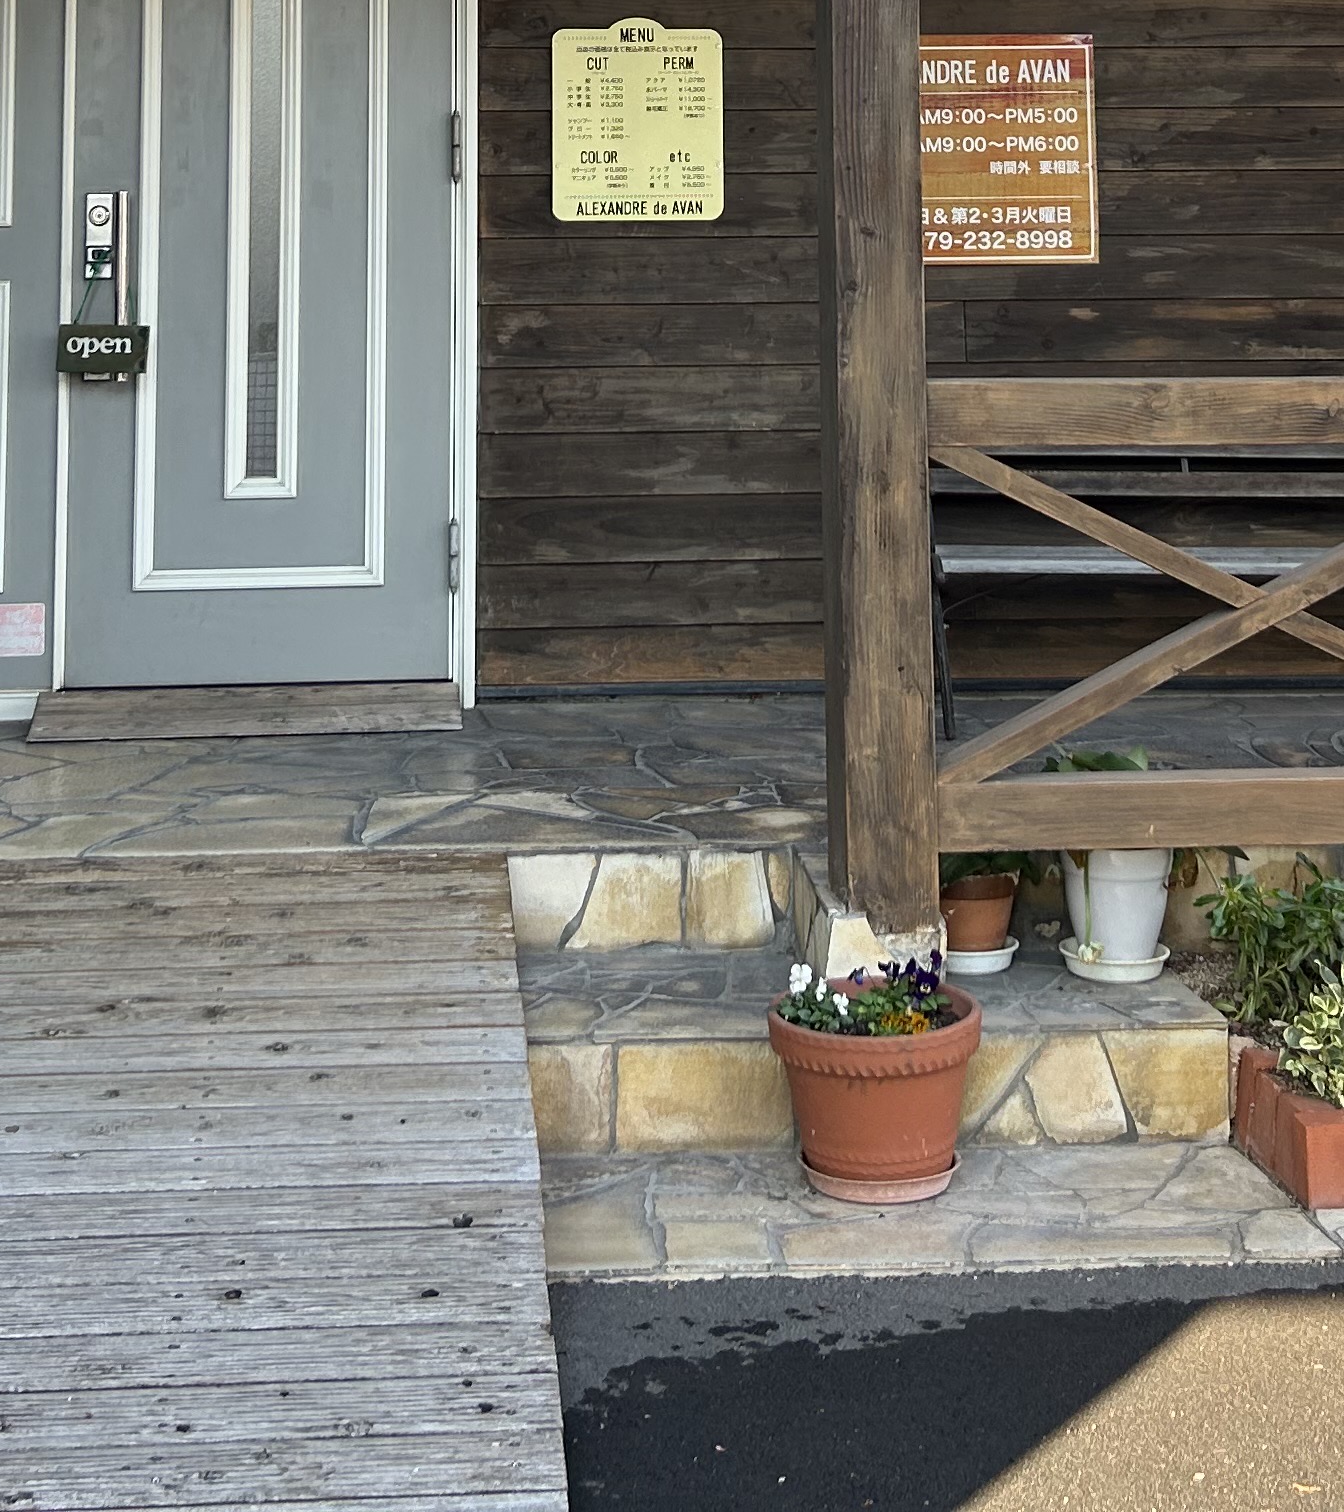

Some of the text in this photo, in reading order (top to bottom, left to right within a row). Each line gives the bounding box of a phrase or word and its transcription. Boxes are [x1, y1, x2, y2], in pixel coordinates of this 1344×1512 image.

[619, 28, 655, 43] MENU
[586, 56, 609, 71] CUT
[663, 56, 695, 70] PERM
[920, 58, 1071, 84] NDRE de AVAN
[580, 150, 618, 164] COLOR
[669, 149, 691, 163] etc
[989, 160, 1081, 175] 時間外 要相談
[576, 200, 703, 216] ALEXANDRE de AVAN
[66, 336, 133, 359] open
